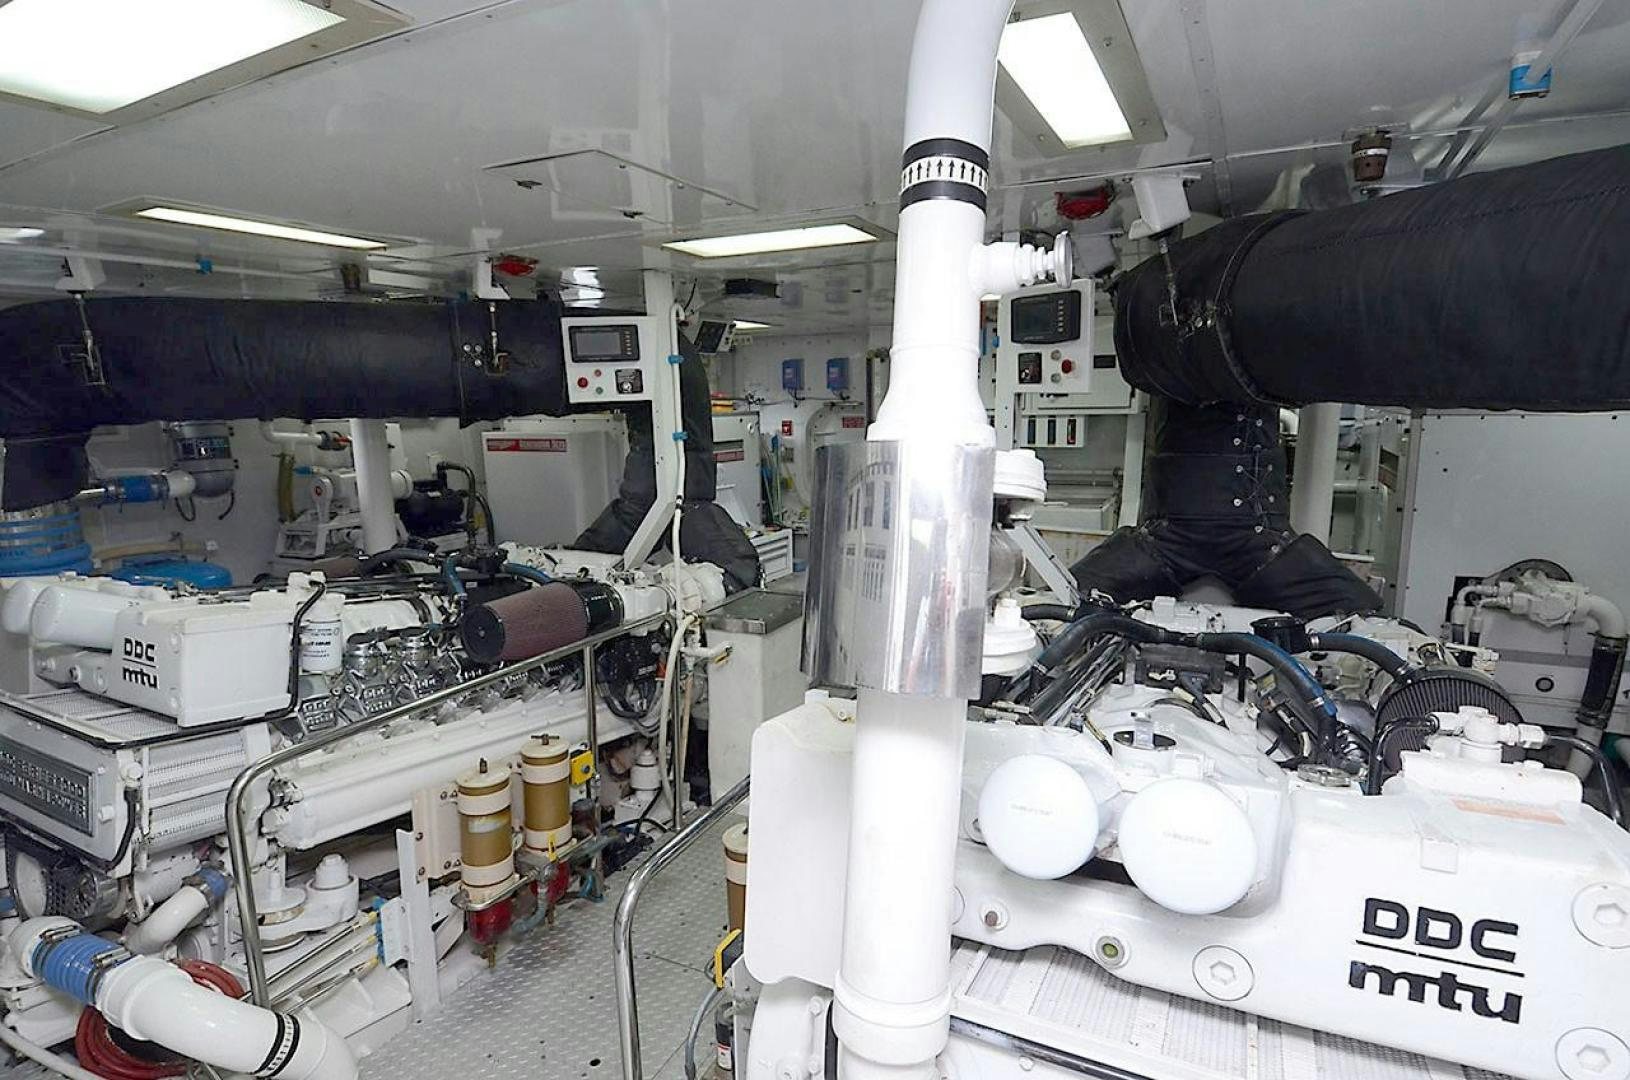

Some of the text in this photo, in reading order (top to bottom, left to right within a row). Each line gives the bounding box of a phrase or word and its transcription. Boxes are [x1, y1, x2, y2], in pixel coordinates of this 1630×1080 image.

[124, 638, 155, 662] DDC
[122, 667, 158, 689] mtu
[1363, 897, 1519, 963] DDC
[1349, 960, 1523, 1024] mtu
